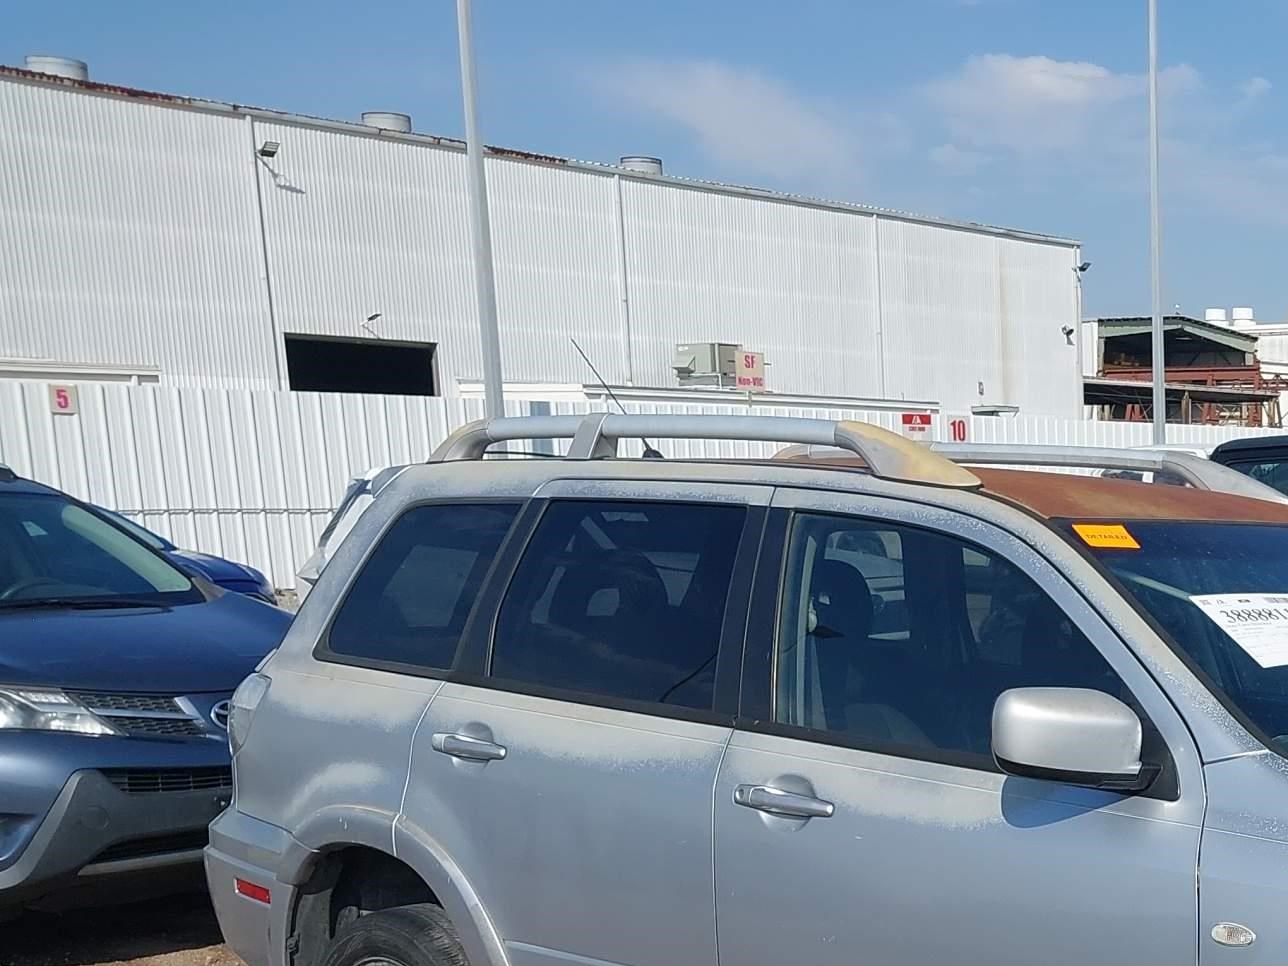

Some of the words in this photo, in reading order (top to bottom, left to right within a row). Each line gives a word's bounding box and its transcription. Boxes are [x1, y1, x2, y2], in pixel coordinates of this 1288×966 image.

[744, 354, 756, 369] SF
[55, 388, 69, 409] 5
[950, 419, 966, 442] 10
